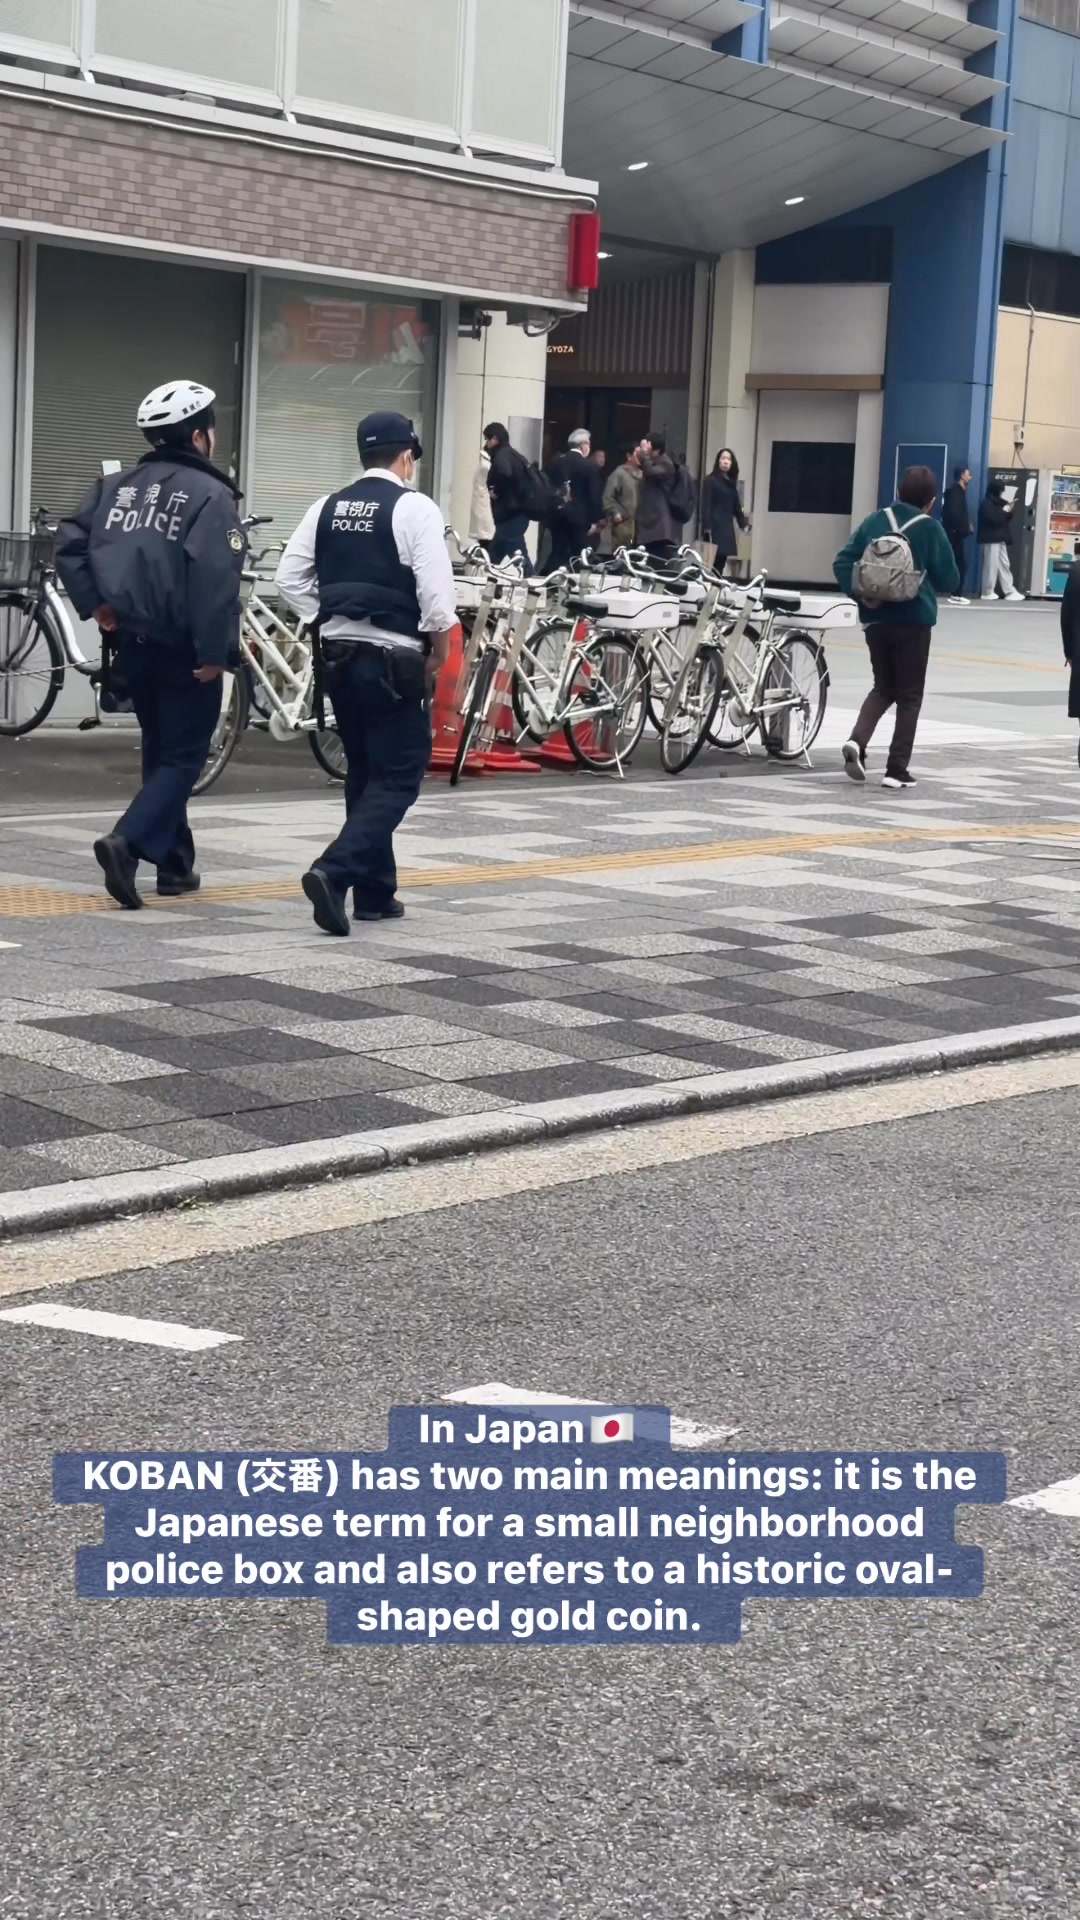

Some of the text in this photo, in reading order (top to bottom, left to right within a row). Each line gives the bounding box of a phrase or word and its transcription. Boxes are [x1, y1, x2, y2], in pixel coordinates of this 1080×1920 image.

[547, 345, 574, 353] GYOZA
[114, 484, 190, 514] 警視庁
[333, 500, 380, 517] 警視庁
[104, 505, 183, 542] POLICE
[331, 519, 374, 532] POLICE
